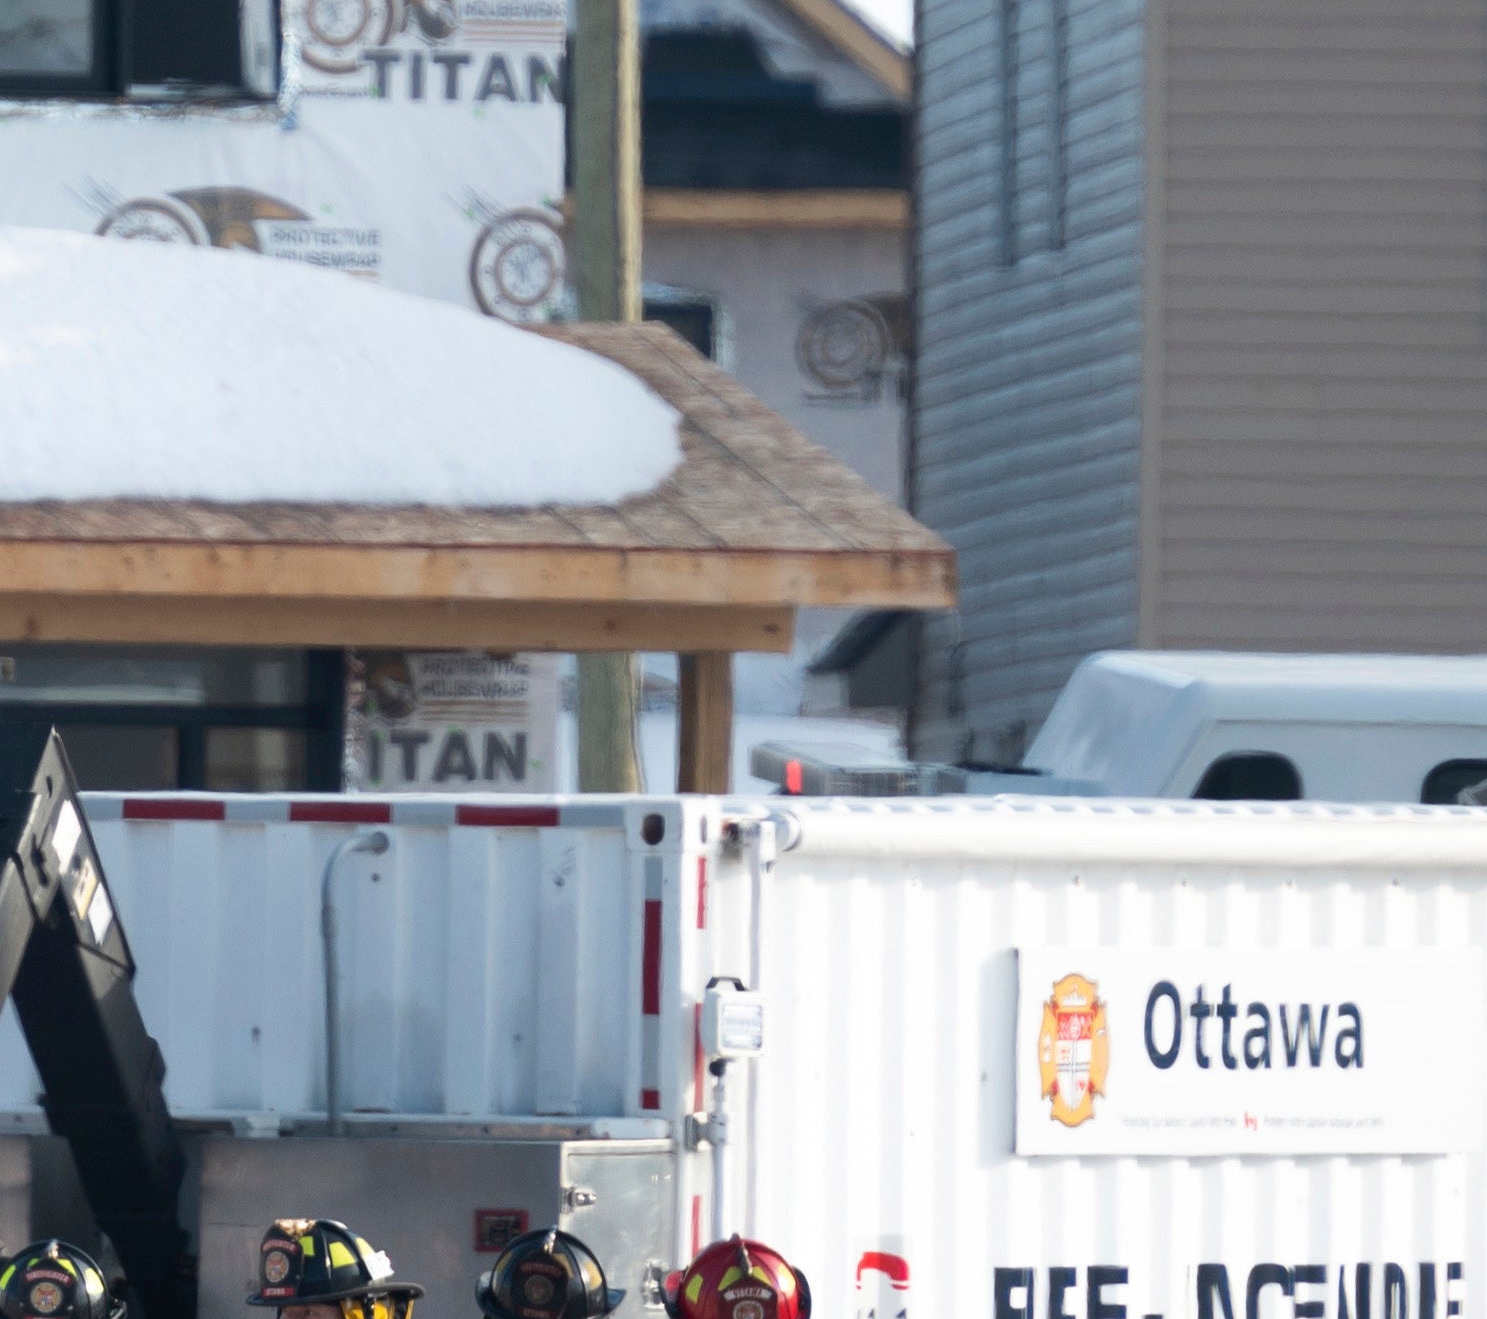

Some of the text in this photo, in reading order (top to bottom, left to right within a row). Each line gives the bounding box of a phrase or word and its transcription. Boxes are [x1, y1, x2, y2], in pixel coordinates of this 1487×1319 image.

[361, 50, 568, 104] TITAN
[367, 729, 529, 783] ITAN
[1144, 980, 1365, 1070] Ottawa
